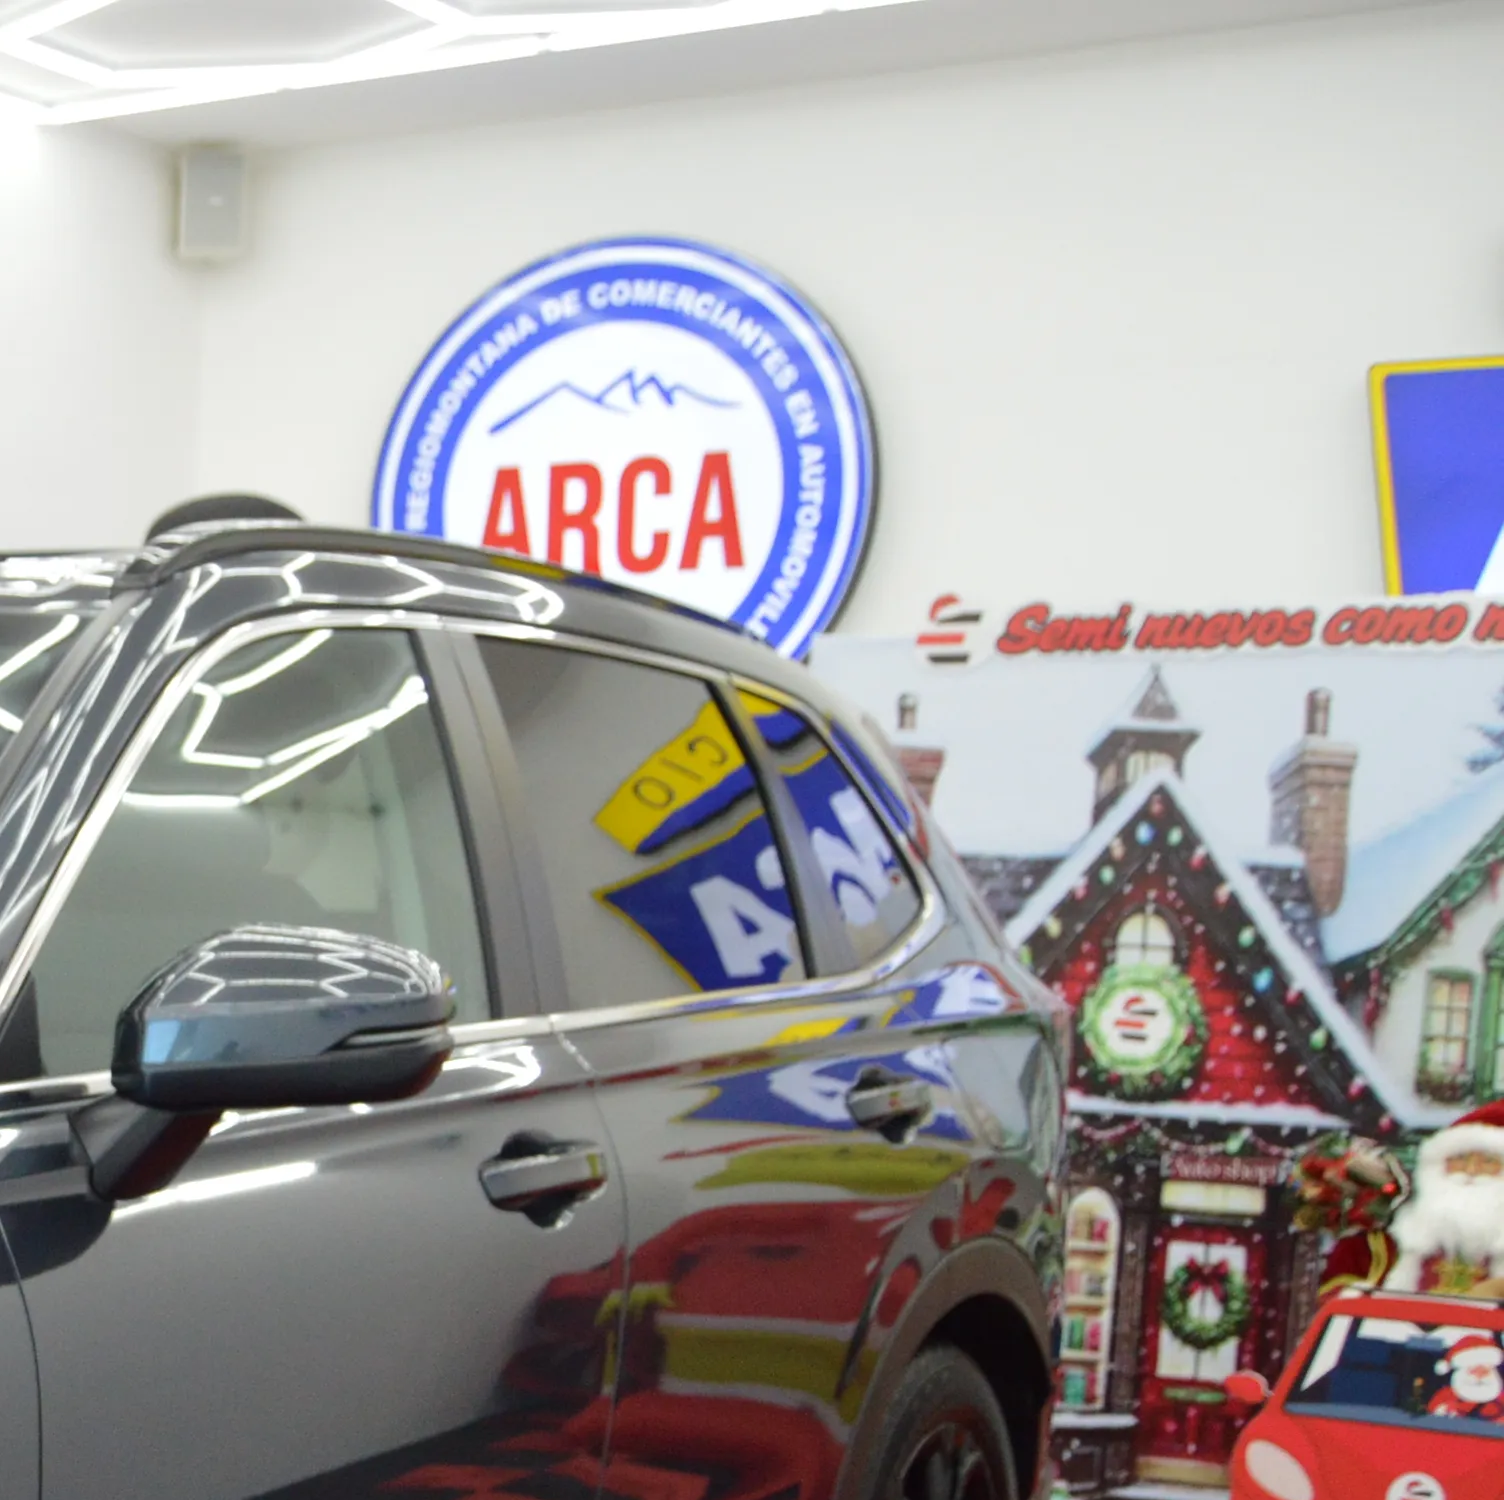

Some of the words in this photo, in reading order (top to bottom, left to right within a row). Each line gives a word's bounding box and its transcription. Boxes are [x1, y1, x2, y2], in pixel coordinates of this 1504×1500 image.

[404, 313, 539, 532] REGIOMONTANA
[540, 287, 584, 326] DE
[586, 277, 799, 397] COMERCIANTES
[785, 391, 820, 438] EN
[481, 450, 746, 577] ARCA
[997, 603, 1133, 655] Semi
[1134, 607, 1316, 650] nuevos
[1322, 602, 1470, 646] como
